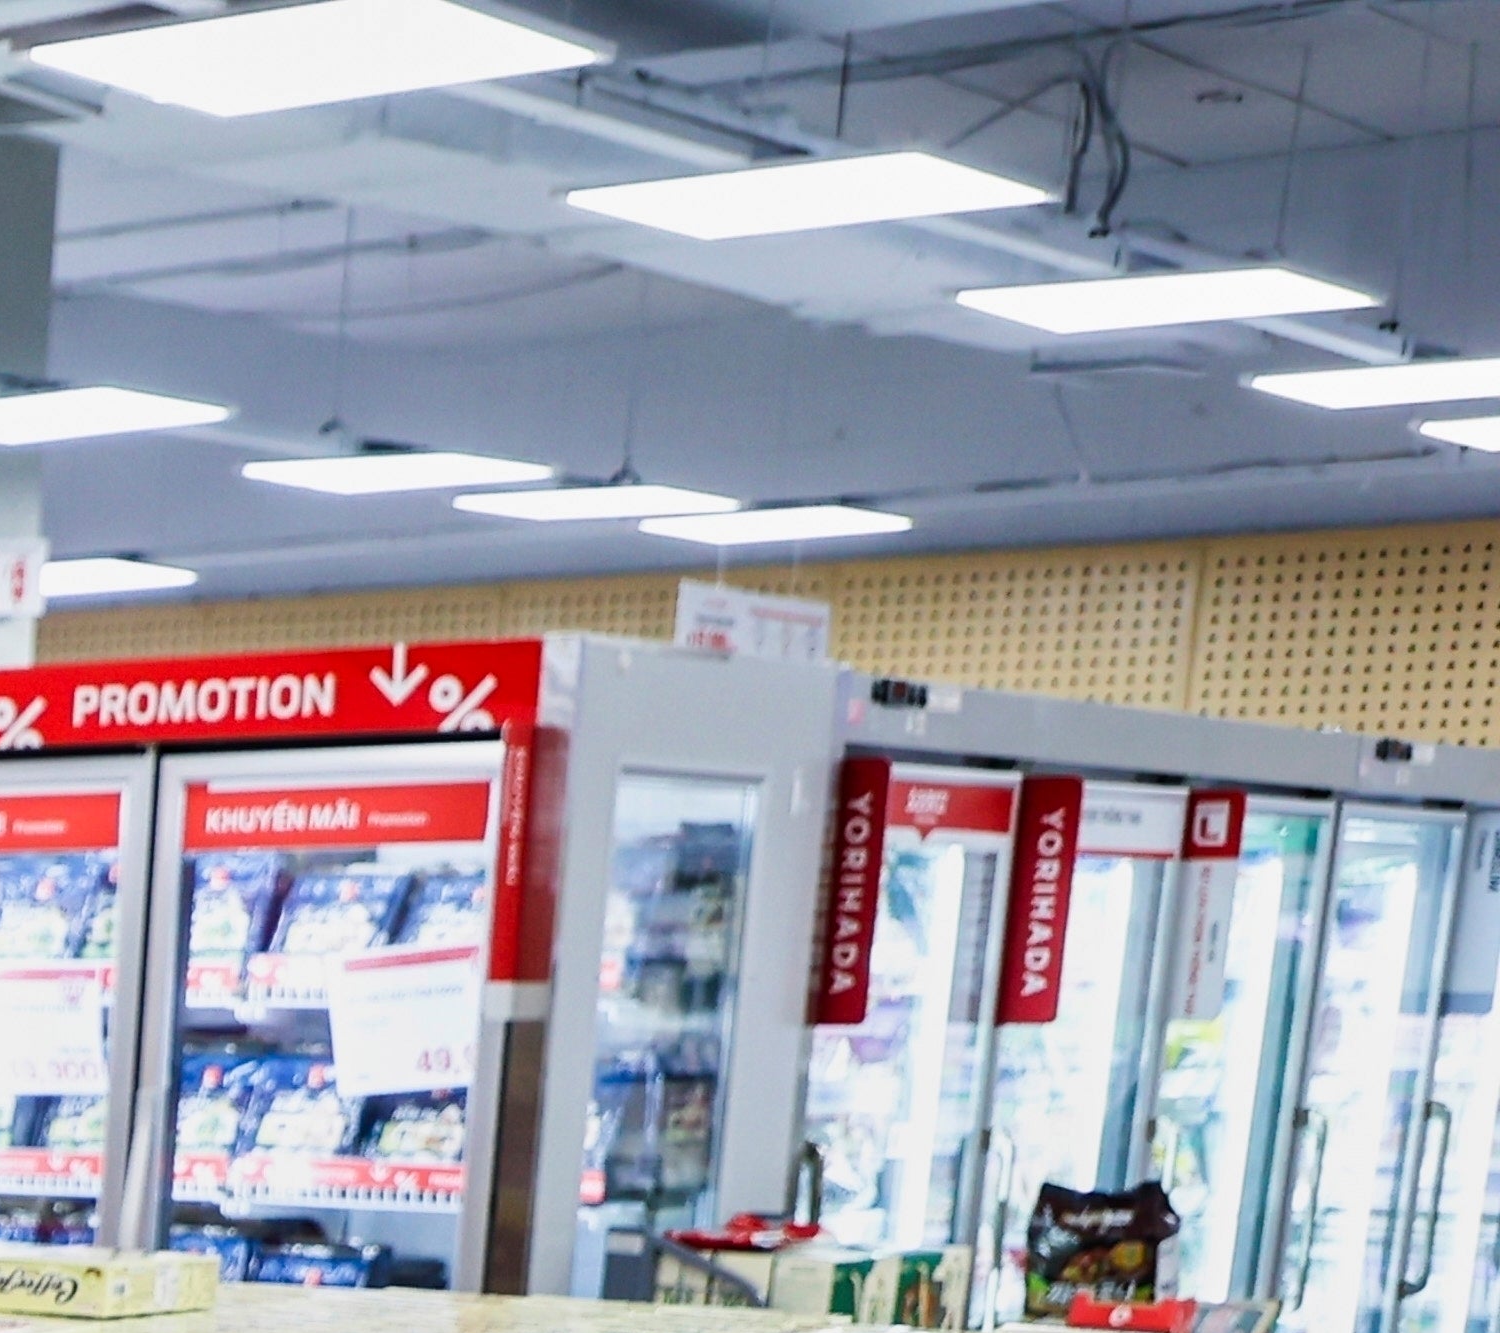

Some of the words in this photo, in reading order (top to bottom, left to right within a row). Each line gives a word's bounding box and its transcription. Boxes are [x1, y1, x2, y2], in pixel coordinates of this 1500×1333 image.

[73, 673, 336, 728] PROMOTION
[827, 789, 876, 998] YORIHADA
[1018, 805, 1067, 1000] YORIHADA
